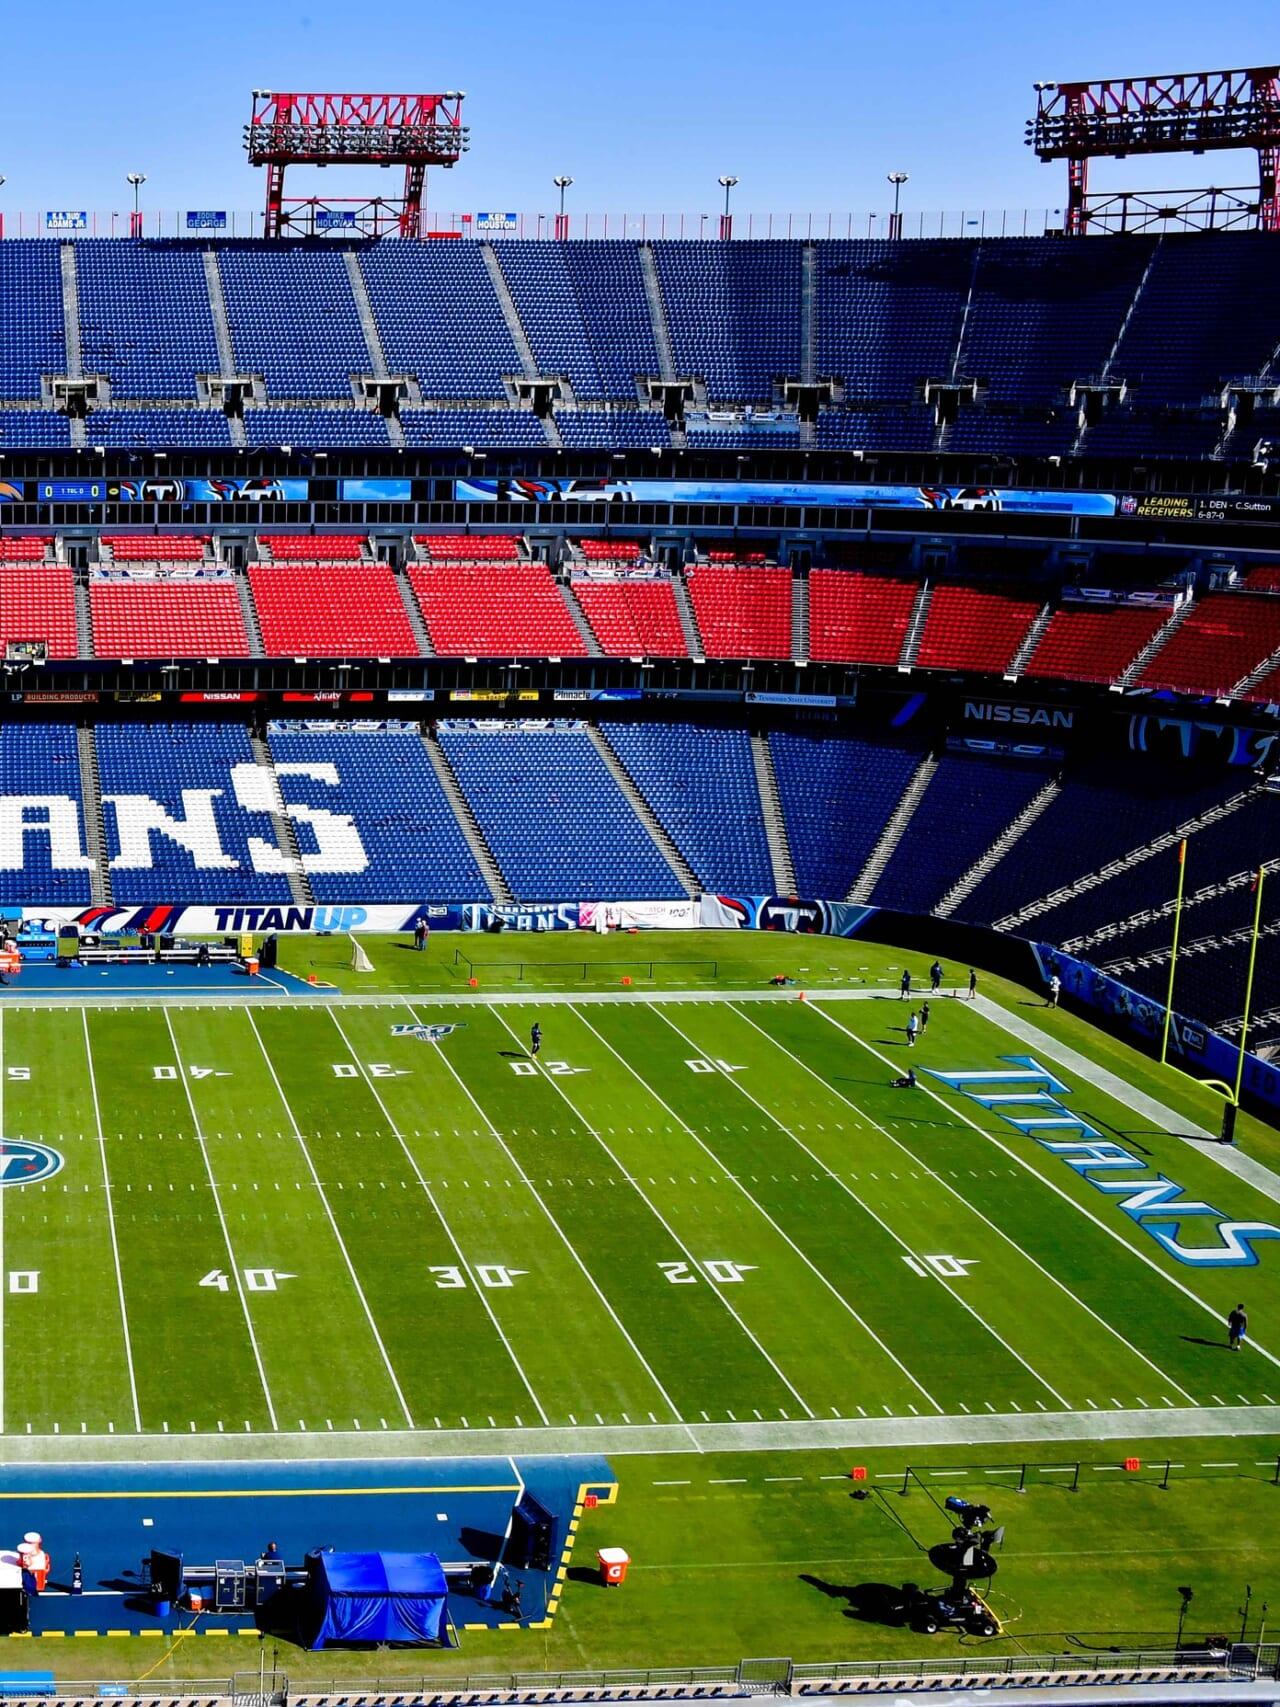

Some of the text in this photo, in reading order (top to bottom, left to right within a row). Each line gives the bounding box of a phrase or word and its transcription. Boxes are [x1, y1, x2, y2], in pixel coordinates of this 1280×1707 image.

[196, 212, 216, 220] EDDIE
[48, 220, 72, 228] ADAMS
[188, 220, 225, 228] GEORGE
[478, 221, 516, 230] HOUSTON
[44, 486, 52, 497] 0
[91, 486, 98, 497] 0
[1143, 498, 1188, 507] LEADING
[1210, 501, 1227, 509] DEN
[1235, 501, 1271, 510] C.Sutton
[1136, 507, 1192, 517] RECEIVERS
[313, 692, 342, 701] xfinity
[555, 691, 591, 699] Pinnacle
[964, 702, 1073, 728] NISSAN
[917, 1055, 1280, 1267] TITANS
[900, 1255, 970, 1277] 10
[428, 1265, 514, 1288] 30
[656, 1260, 744, 1284] 20
[198, 1268, 278, 1292] 40
[608, 1566, 621, 1578] G
